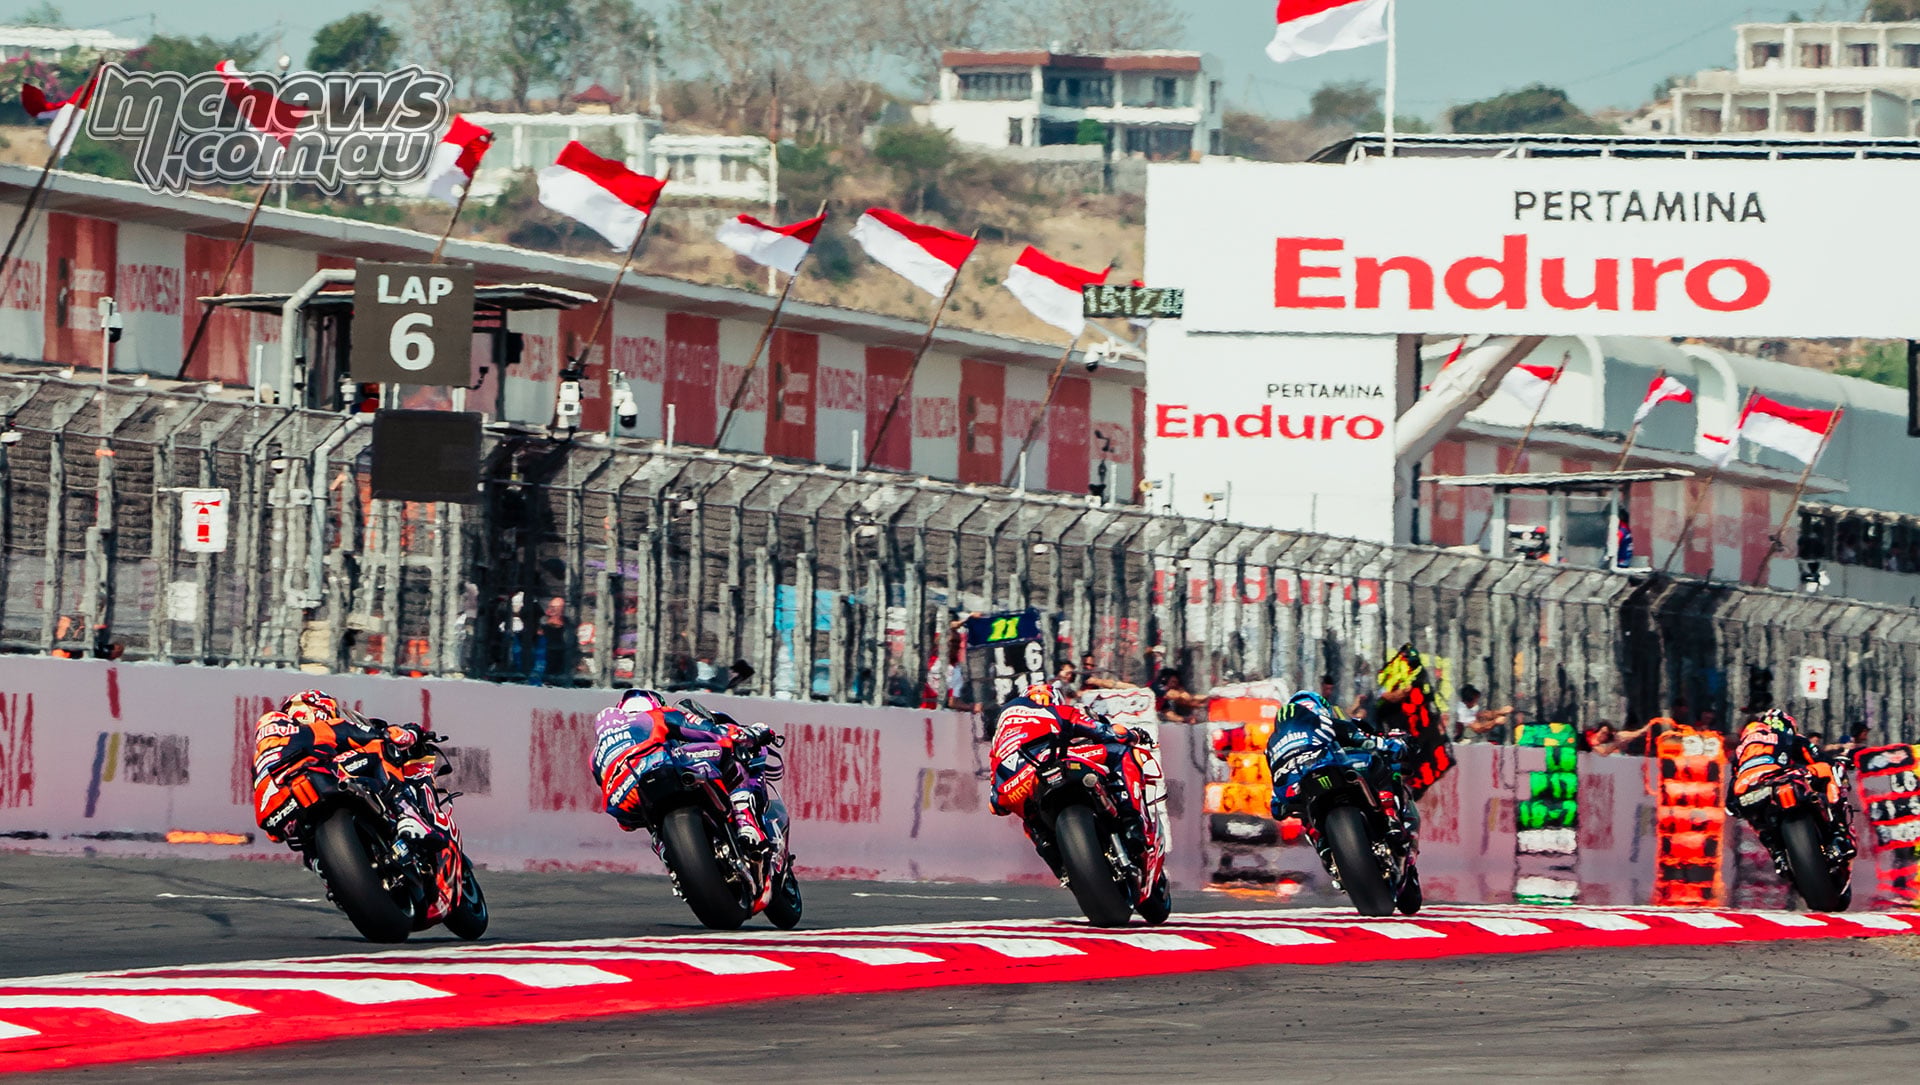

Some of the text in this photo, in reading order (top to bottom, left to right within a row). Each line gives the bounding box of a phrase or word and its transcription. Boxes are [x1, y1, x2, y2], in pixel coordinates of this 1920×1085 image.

[1515, 191, 1766, 222] PERTAMINA
[377, 274, 454, 305] LAP
[1274, 234, 1771, 312] Enduro
[389, 312, 435, 371] 6
[1267, 383, 1383, 397] PERTAMINA
[1156, 404, 1385, 440] Enduro
